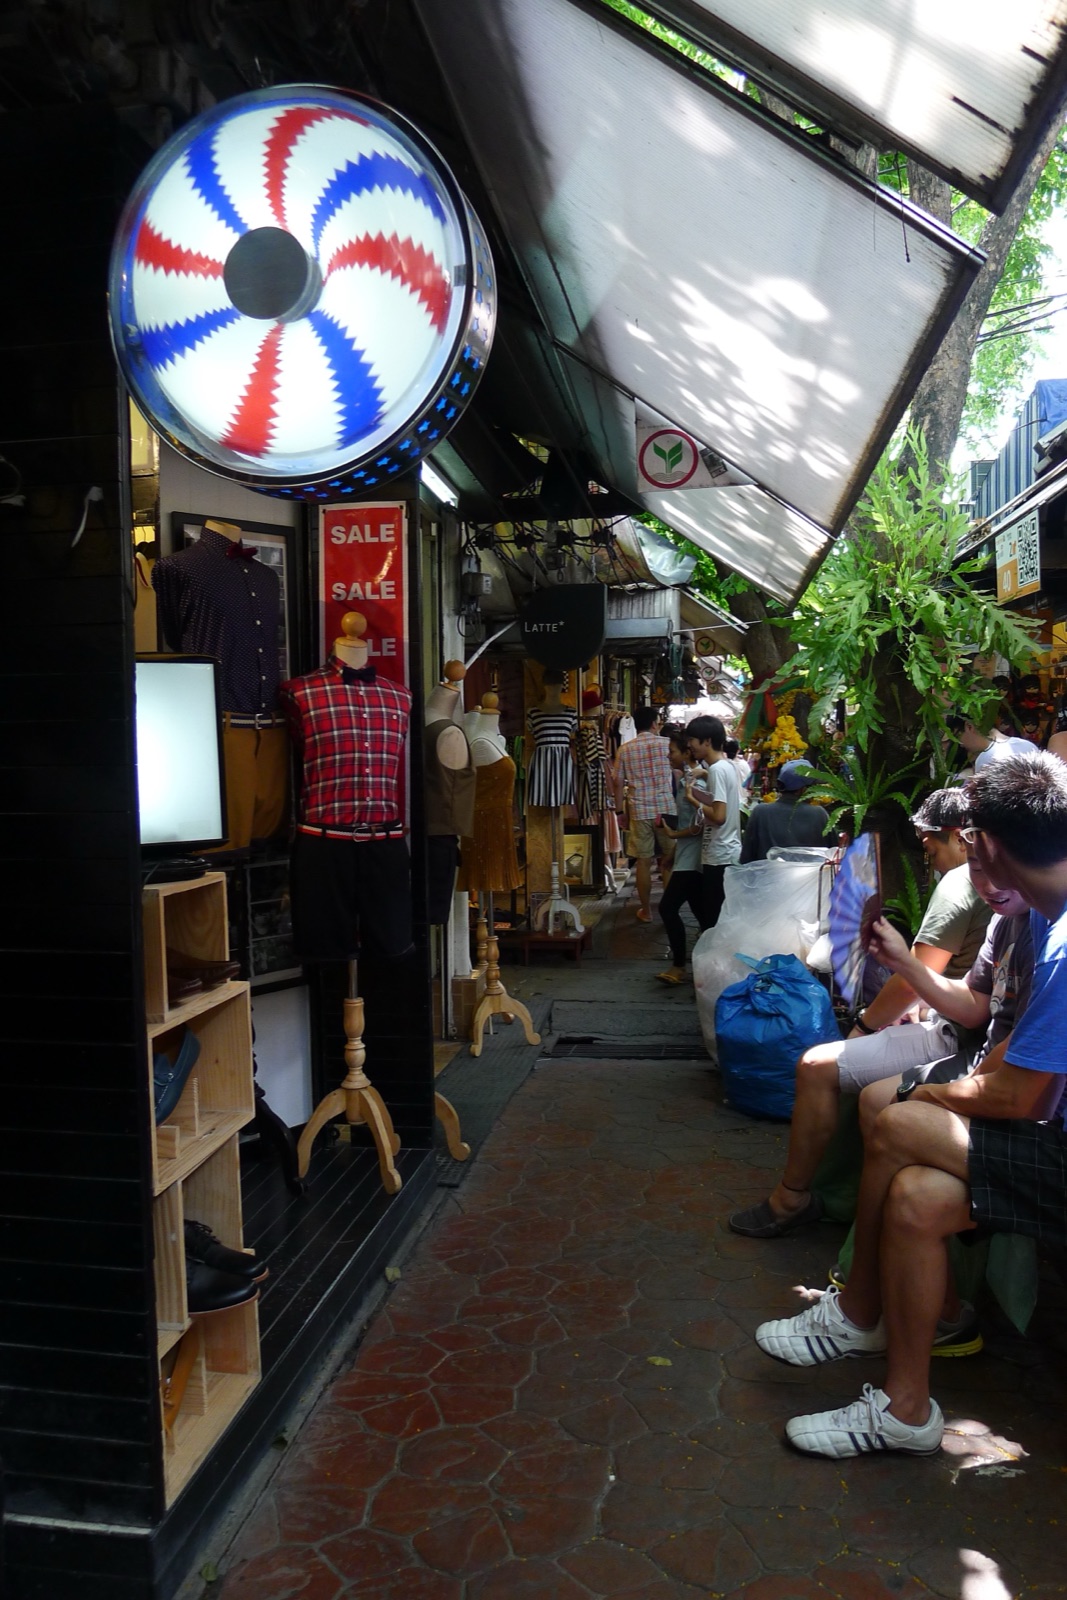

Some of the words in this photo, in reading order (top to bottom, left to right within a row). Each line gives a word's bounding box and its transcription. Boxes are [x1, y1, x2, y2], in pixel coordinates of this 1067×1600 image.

[331, 524, 395, 545] SALE
[331, 581, 396, 601] SALE
[367, 638, 397, 657] LE
